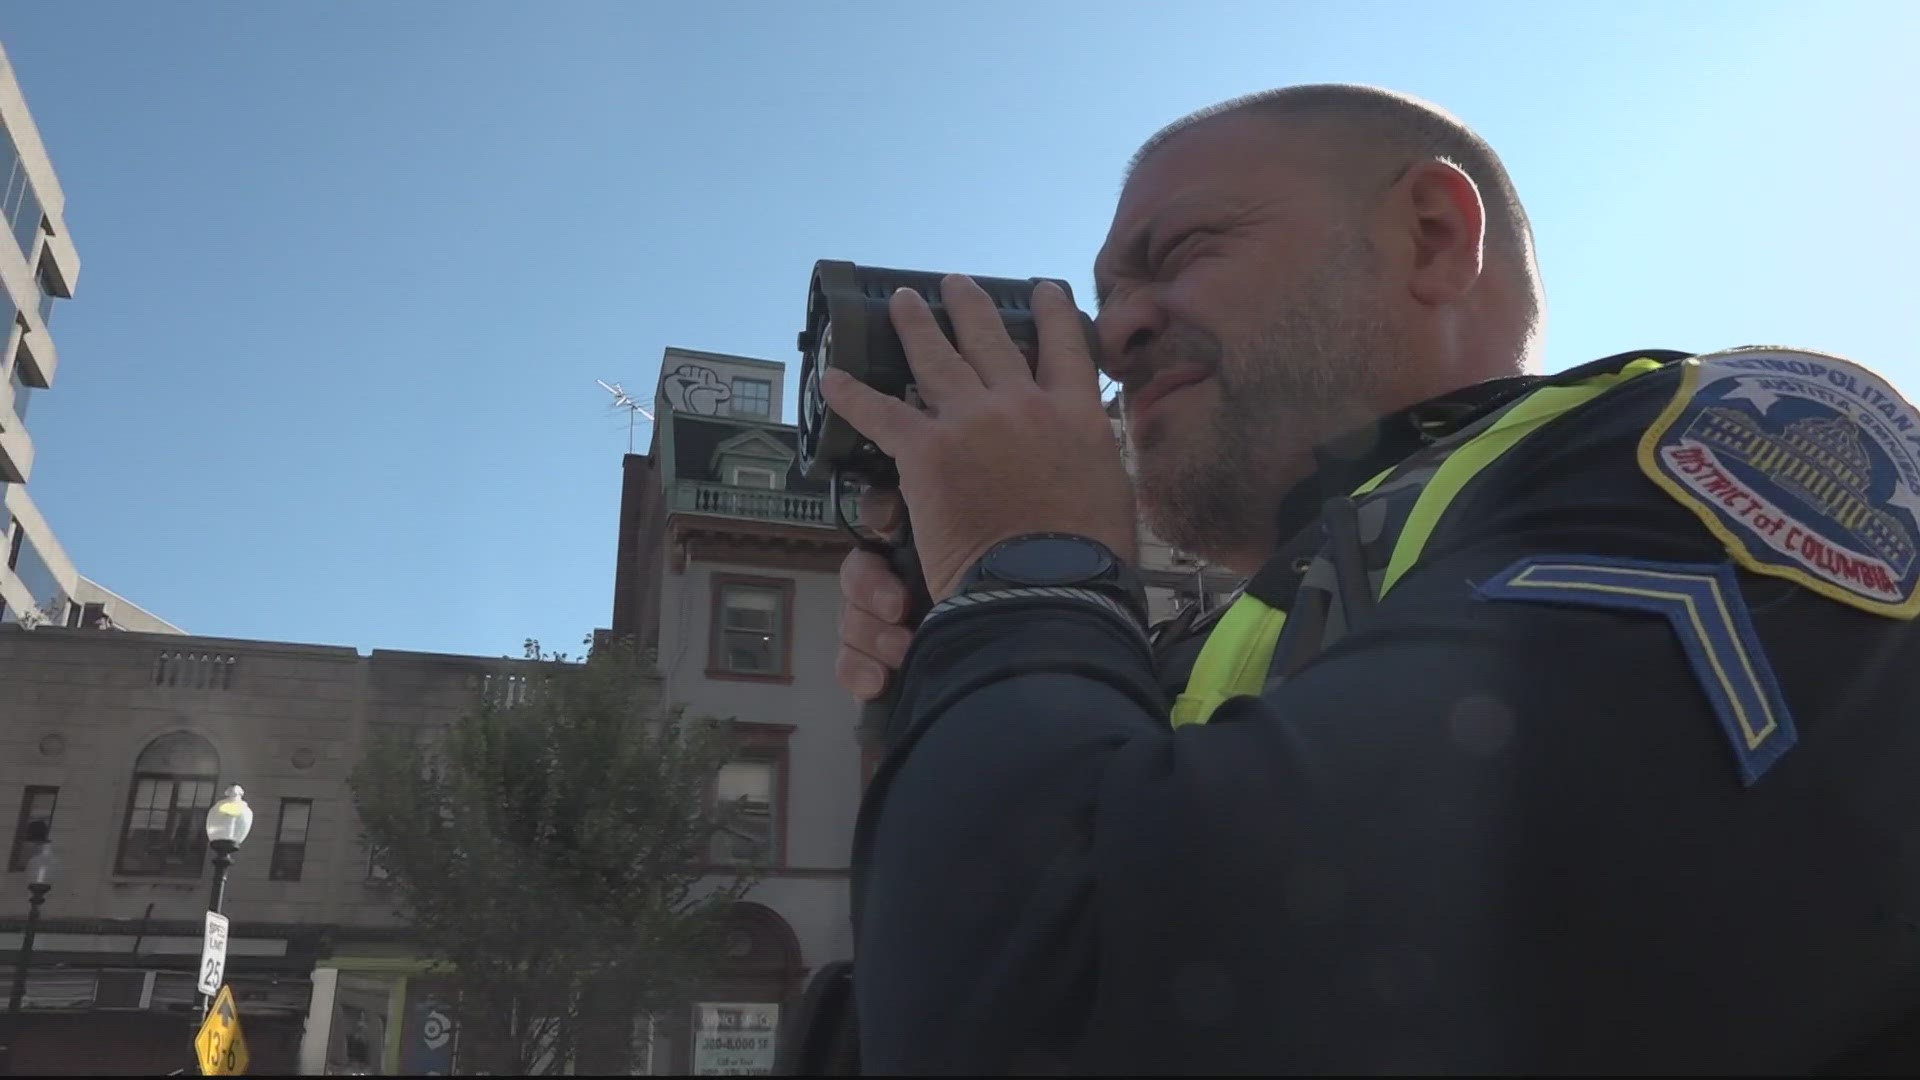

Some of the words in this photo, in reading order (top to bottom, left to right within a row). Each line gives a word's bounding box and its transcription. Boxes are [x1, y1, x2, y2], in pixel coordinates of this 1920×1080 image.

[1671, 447, 1764, 518] DISTRICT
[1753, 515, 1786, 536] of
[1784, 526, 1899, 595] COLUMBIA
[204, 957, 221, 988] 25
